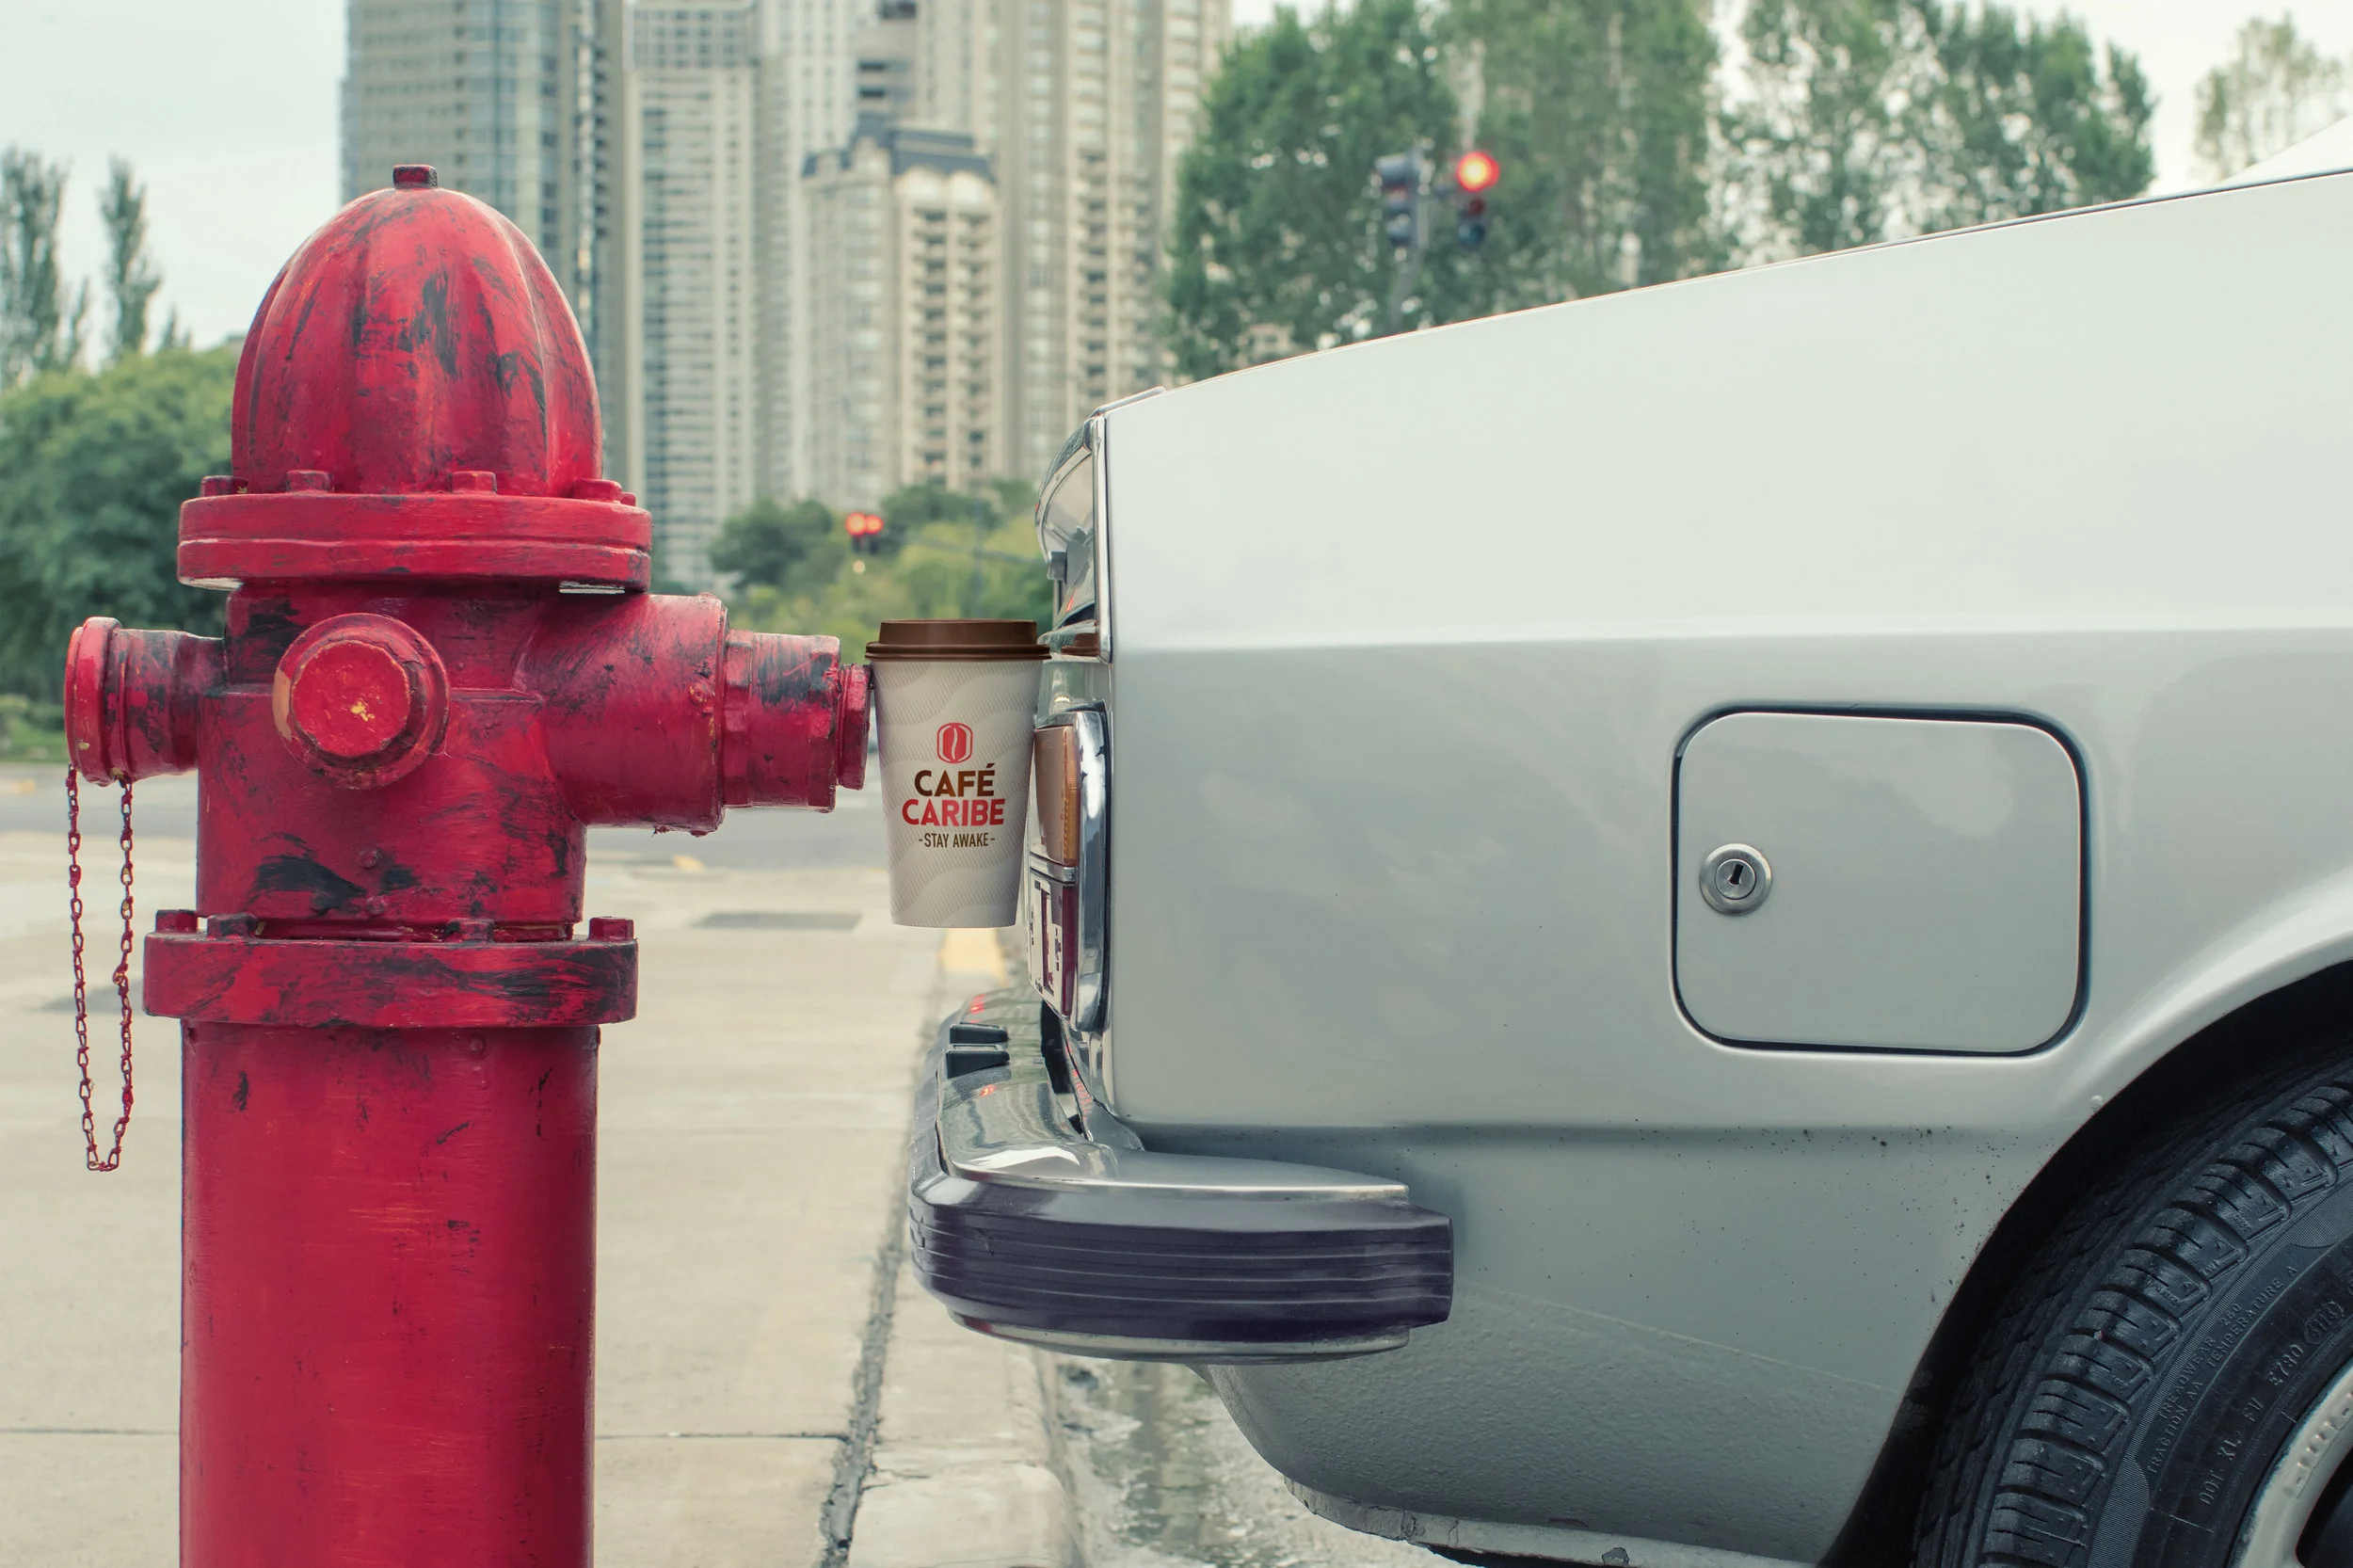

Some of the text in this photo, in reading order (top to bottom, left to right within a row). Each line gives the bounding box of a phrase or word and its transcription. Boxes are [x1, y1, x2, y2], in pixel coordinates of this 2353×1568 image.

[914, 762, 996, 797] CAFÉ
[902, 798, 1005, 826] CARIBE
[2147, 1265, 2298, 1474] TRACTION AA TEMPERATURE A
[2158, 1336, 2217, 1419] TREADWEAR
[2199, 1469, 2224, 1505] DOT
